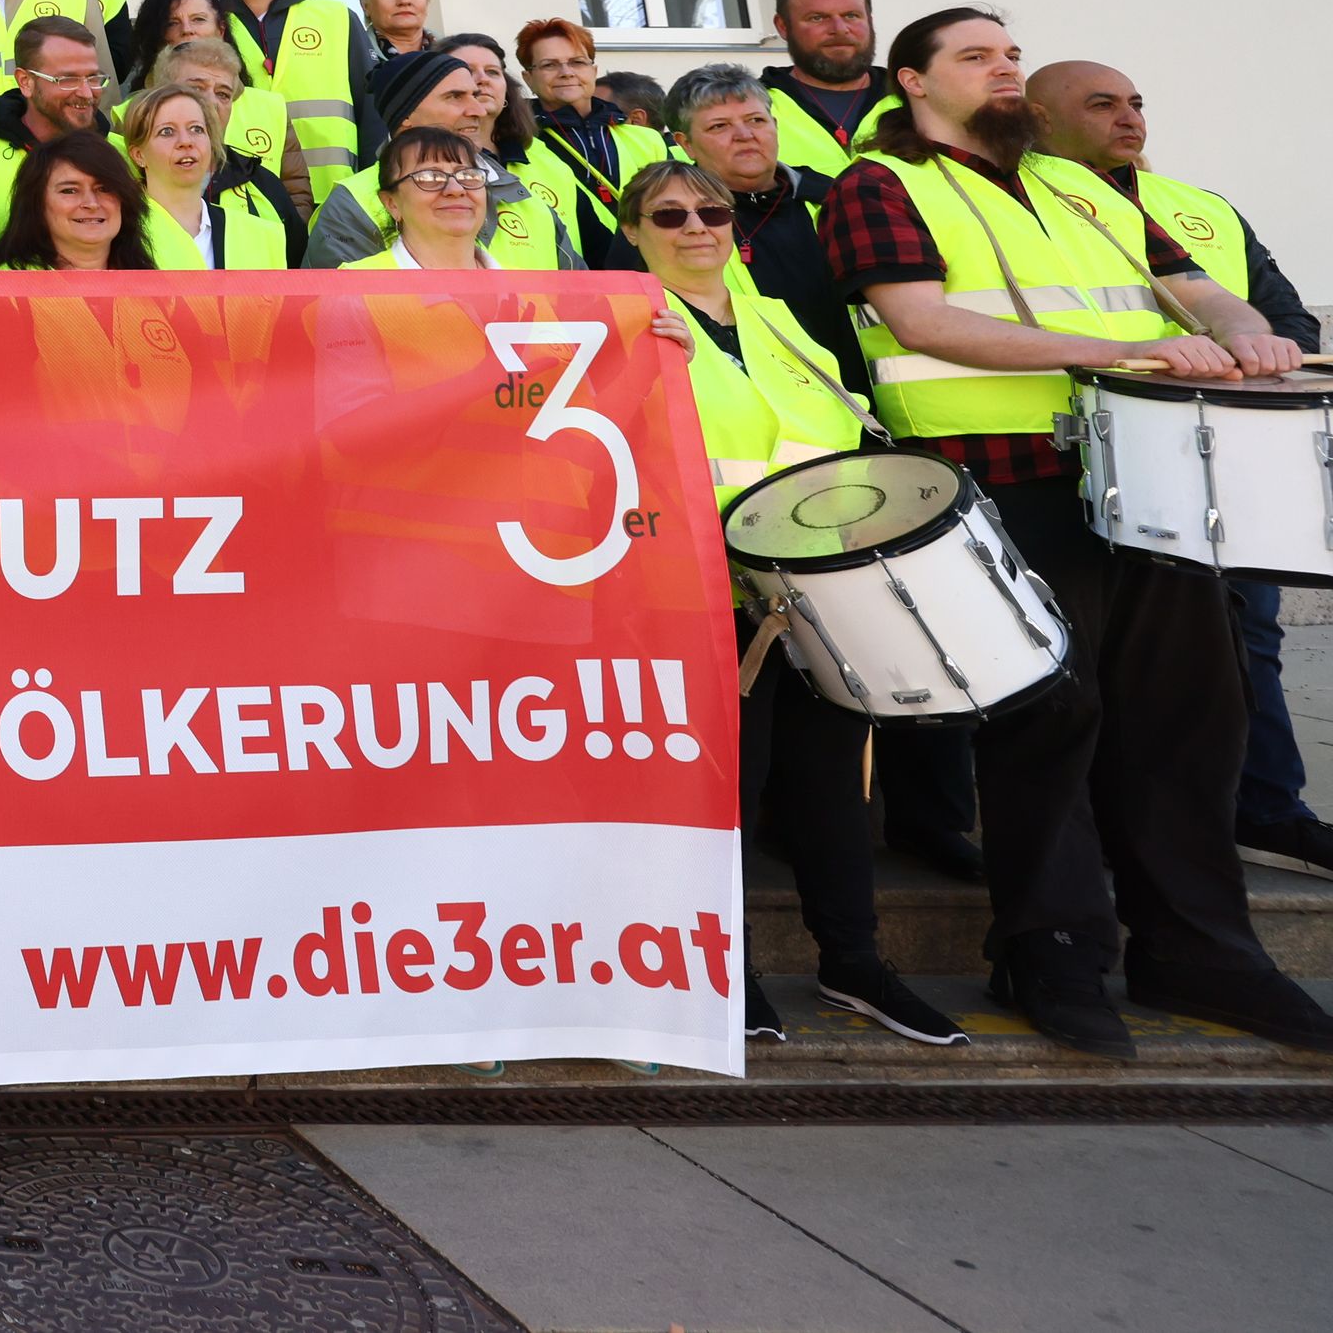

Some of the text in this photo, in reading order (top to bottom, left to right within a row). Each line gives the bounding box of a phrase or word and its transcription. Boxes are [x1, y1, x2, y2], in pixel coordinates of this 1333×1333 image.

[495, 372, 545, 408] die
[484, 321, 640, 586] 3
[624, 510, 661, 537] er
[21, 901, 731, 1009] www.die3er.at
